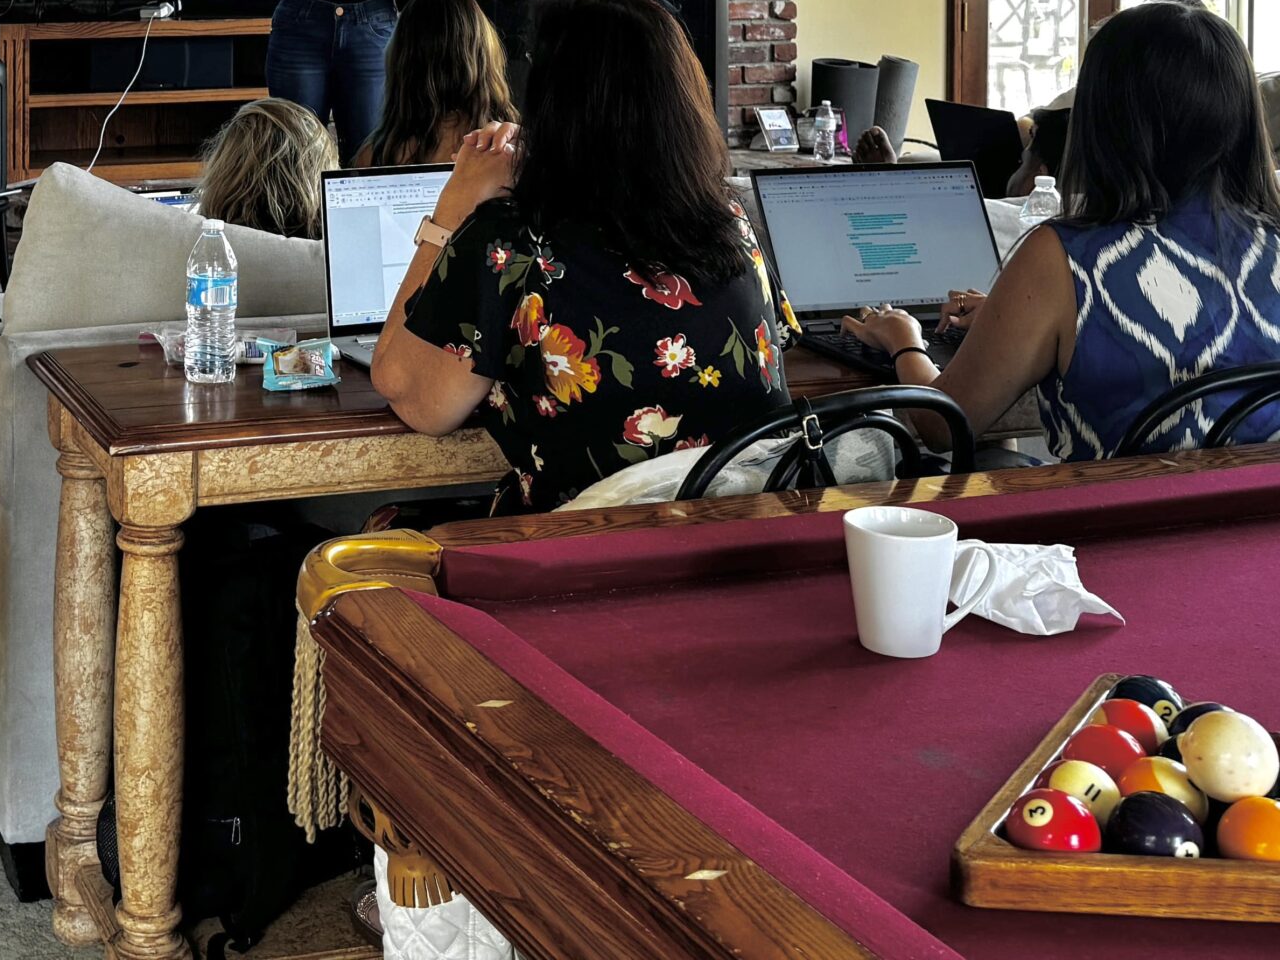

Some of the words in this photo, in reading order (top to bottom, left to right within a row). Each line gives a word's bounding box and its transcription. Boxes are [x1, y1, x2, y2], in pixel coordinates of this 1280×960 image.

[1160, 706, 1173, 723] 2
[1083, 783, 1102, 802] 11
[1028, 805, 1046, 819] 3
